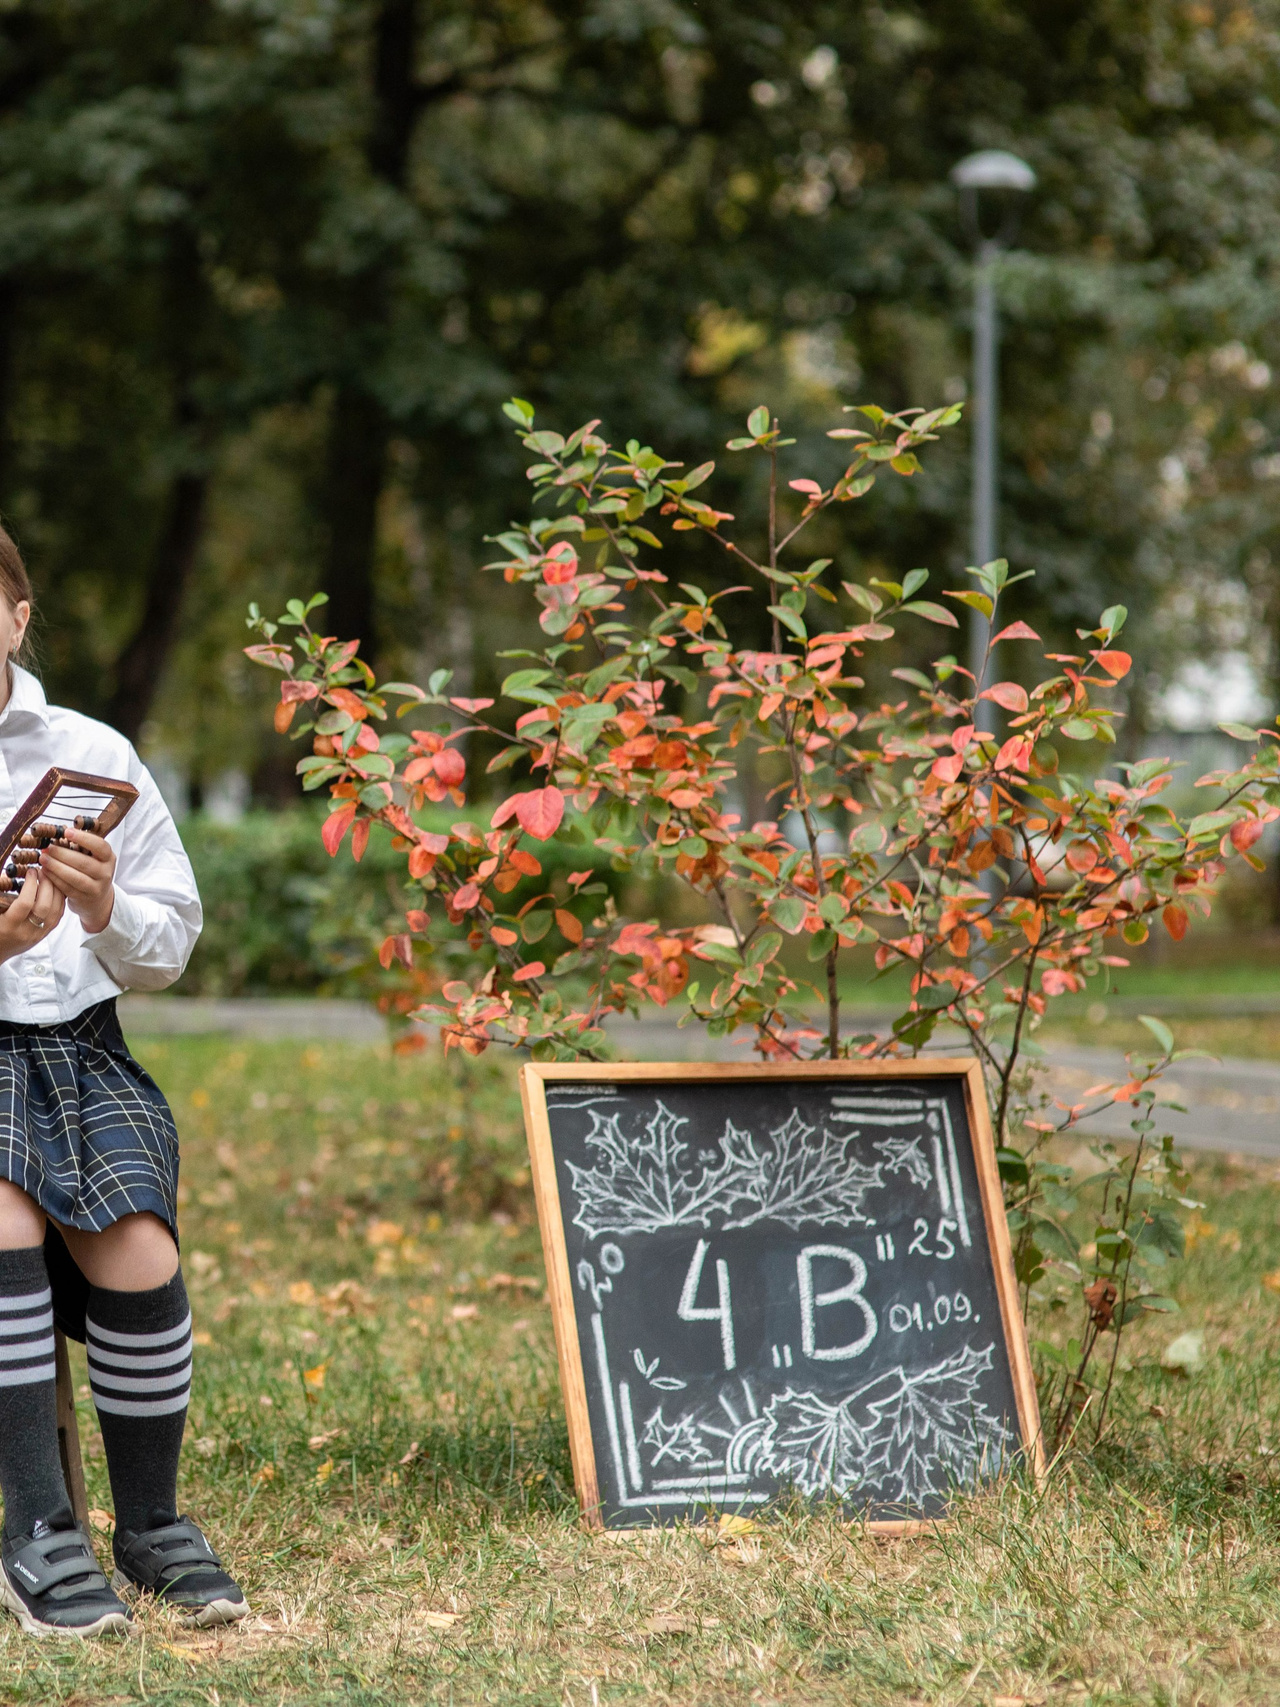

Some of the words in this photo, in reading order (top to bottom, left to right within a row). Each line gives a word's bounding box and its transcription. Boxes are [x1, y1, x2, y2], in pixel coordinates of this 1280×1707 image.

[908, 1218, 958, 1260] 25
[577, 1242, 625, 1310] 20
[677, 1238, 736, 1371] 4
[889, 1292, 981, 1332] 01.09.
